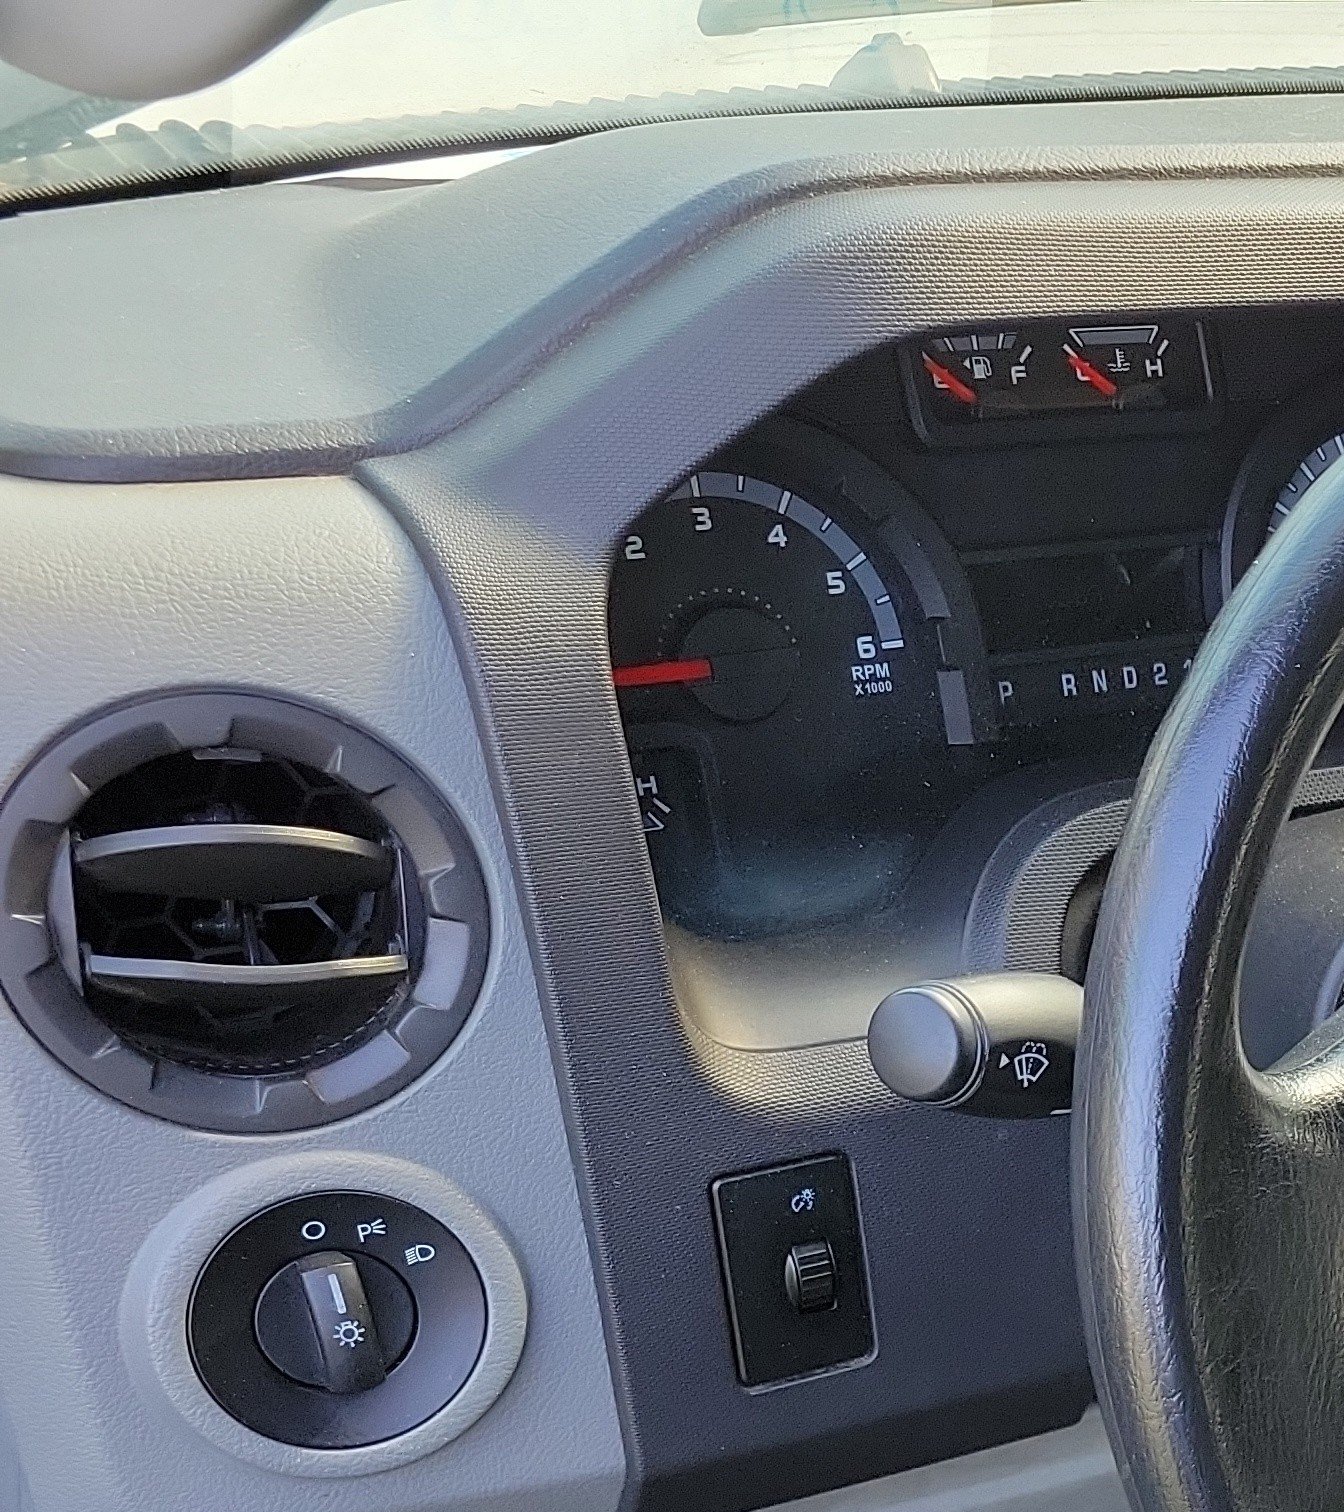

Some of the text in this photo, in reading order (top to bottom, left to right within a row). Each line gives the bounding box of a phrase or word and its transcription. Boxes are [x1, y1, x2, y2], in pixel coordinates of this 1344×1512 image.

[1010, 365, 1027, 385] F
[1145, 358, 1164, 378] H
[691, 507, 713, 531] 3
[625, 535, 646, 560] 2
[767, 524, 788, 548] 4
[826, 570, 846, 595] 5
[856, 635, 877, 659] 6
[851, 662, 891, 682] RPM
[1060, 673, 1078, 697] R
[1091, 668, 1109, 693] N
[1122, 666, 1138, 690] D
[1152, 662, 1169, 686] 2
